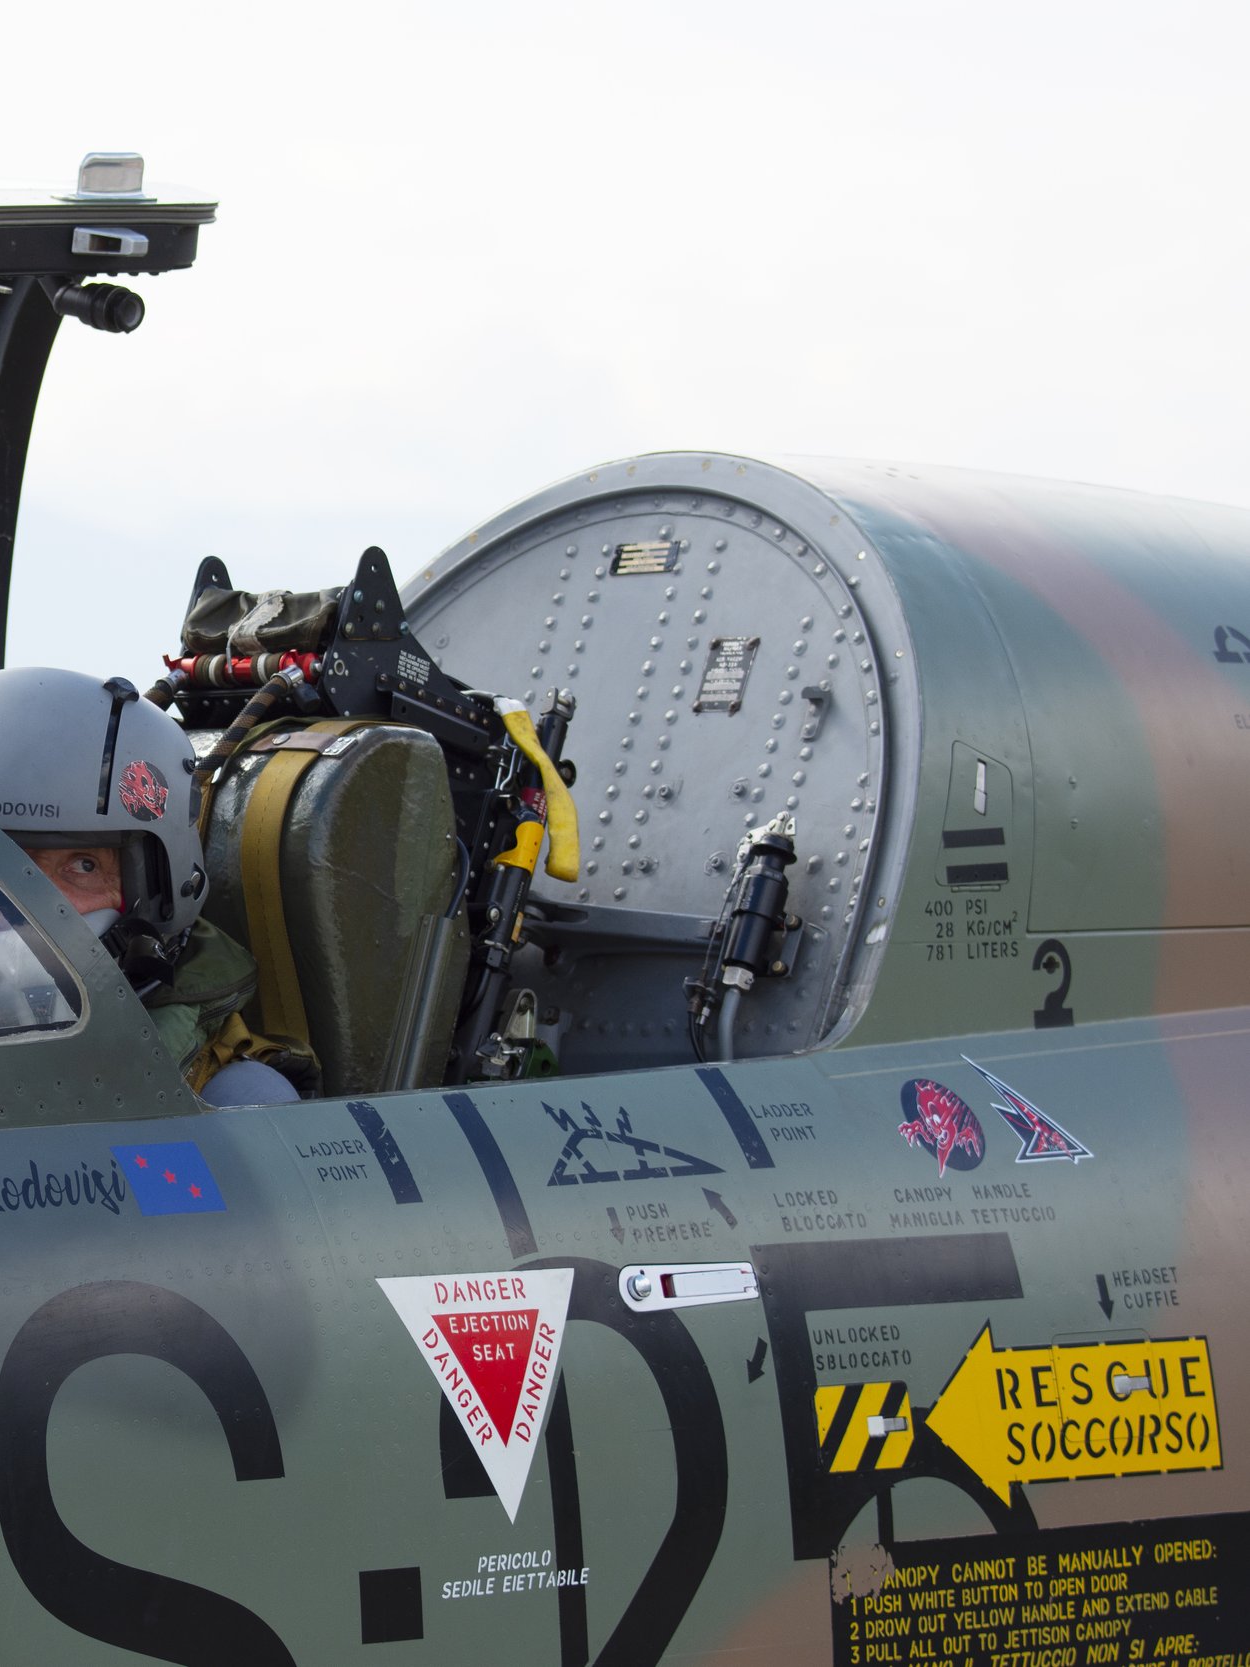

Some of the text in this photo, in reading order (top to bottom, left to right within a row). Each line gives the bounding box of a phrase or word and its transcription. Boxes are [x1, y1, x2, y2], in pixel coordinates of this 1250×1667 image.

[925, 899, 987, 917] 400 PSI
[936, 922, 954, 938] 28
[927, 941, 1019, 961] 781 LITERS
[749, 1101, 814, 1119] LADDER
[771, 1124, 817, 1142] POINT
[295, 1139, 367, 1160] LADDER
[317, 1163, 369, 1183] POINT
[773, 1189, 838, 1208] LOCKED
[894, 1183, 1032, 1204] CANOPY HANDLE
[627, 1203, 669, 1221] PUSH
[783, 1212, 867, 1233] BLOCCATO
[890, 1205, 1057, 1229] MANIGLIA TETTUCCIO
[632, 1221, 712, 1245] PREMERE
[1113, 1267, 1179, 1288] HEADSET
[434, 1277, 526, 1304] DANGER
[1124, 1290, 1180, 1310] CUFFIE
[449, 1314, 530, 1334] EJECTION
[813, 1325, 900, 1345] UNLOCKED
[472, 1343, 515, 1362] SEAT
[815, 1349, 912, 1371] SBLOCCATO
[422, 1328, 493, 1446] DANGER
[515, 1322, 556, 1442] DANGER
[996, 1356, 1206, 1410] RESCUE
[1007, 1411, 1209, 1465] SOCCORSO
[478, 1549, 551, 1573] PERICOLO
[880, 1564, 939, 1590] ANOPY
[952, 1557, 1016, 1583] CANNOT
[1027, 1555, 1048, 1576] BE
[1058, 1545, 1143, 1573] MANUALLY
[1154, 1539, 1218, 1563] OPENED:
[441, 1567, 590, 1600] SEDILE EIETTABILE
[850, 1572, 1128, 1617] 1 PUSH WHITE BUTTON TO OPEN DOOR
[850, 1586, 1218, 1641] 2 DROW OUT YELLOW HANDLE AND EXTEND CABLE
[851, 1645, 860, 1664] 3
[866, 1642, 902, 1663] PULL
[909, 1637, 936, 1658] ALL
[943, 1634, 971, 1655] OUT
[980, 1632, 997, 1651] TO
[1004, 1625, 1070, 1650] JETTISON
[1076, 1617, 1132, 1641] CANOPY
[1086, 1641, 1120, 1665] NON
[1128, 1638, 1145, 1660] SI
[1154, 1633, 1200, 1657] APRE:
